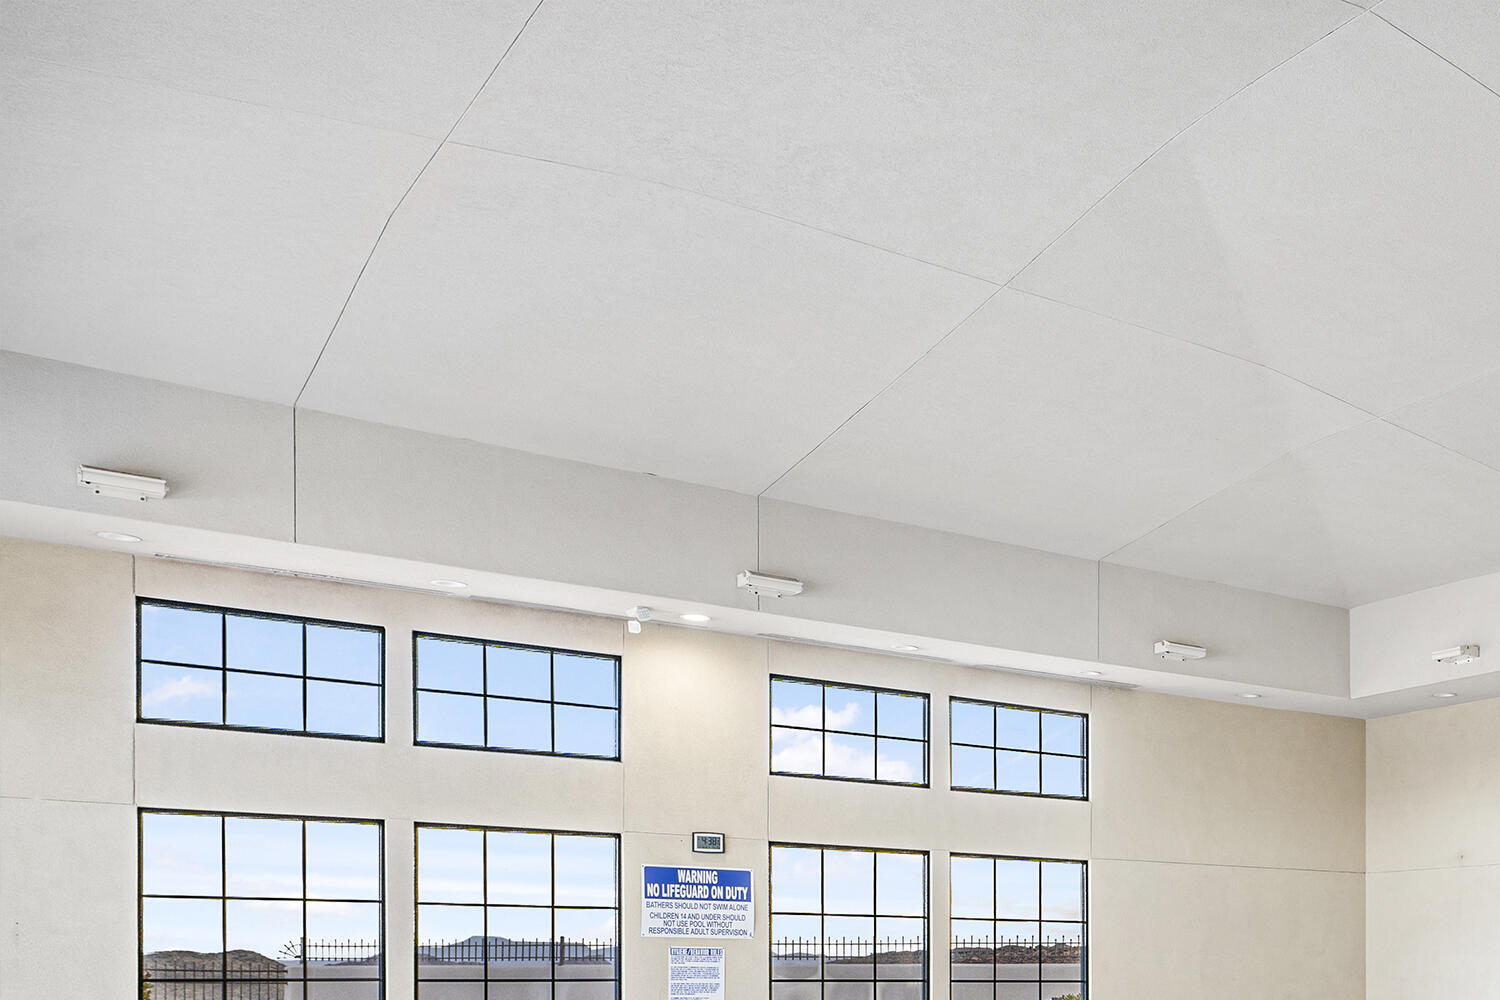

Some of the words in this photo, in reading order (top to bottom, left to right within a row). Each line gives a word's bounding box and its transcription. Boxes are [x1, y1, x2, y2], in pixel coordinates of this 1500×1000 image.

[677, 869, 718, 885] WARNING
[646, 883, 660, 897] NO
[661, 884, 709, 899] LIFEGUARD
[711, 886, 723, 900] ON
[725, 887, 748, 900] DUTY
[646, 901, 674, 909] BATHERS
